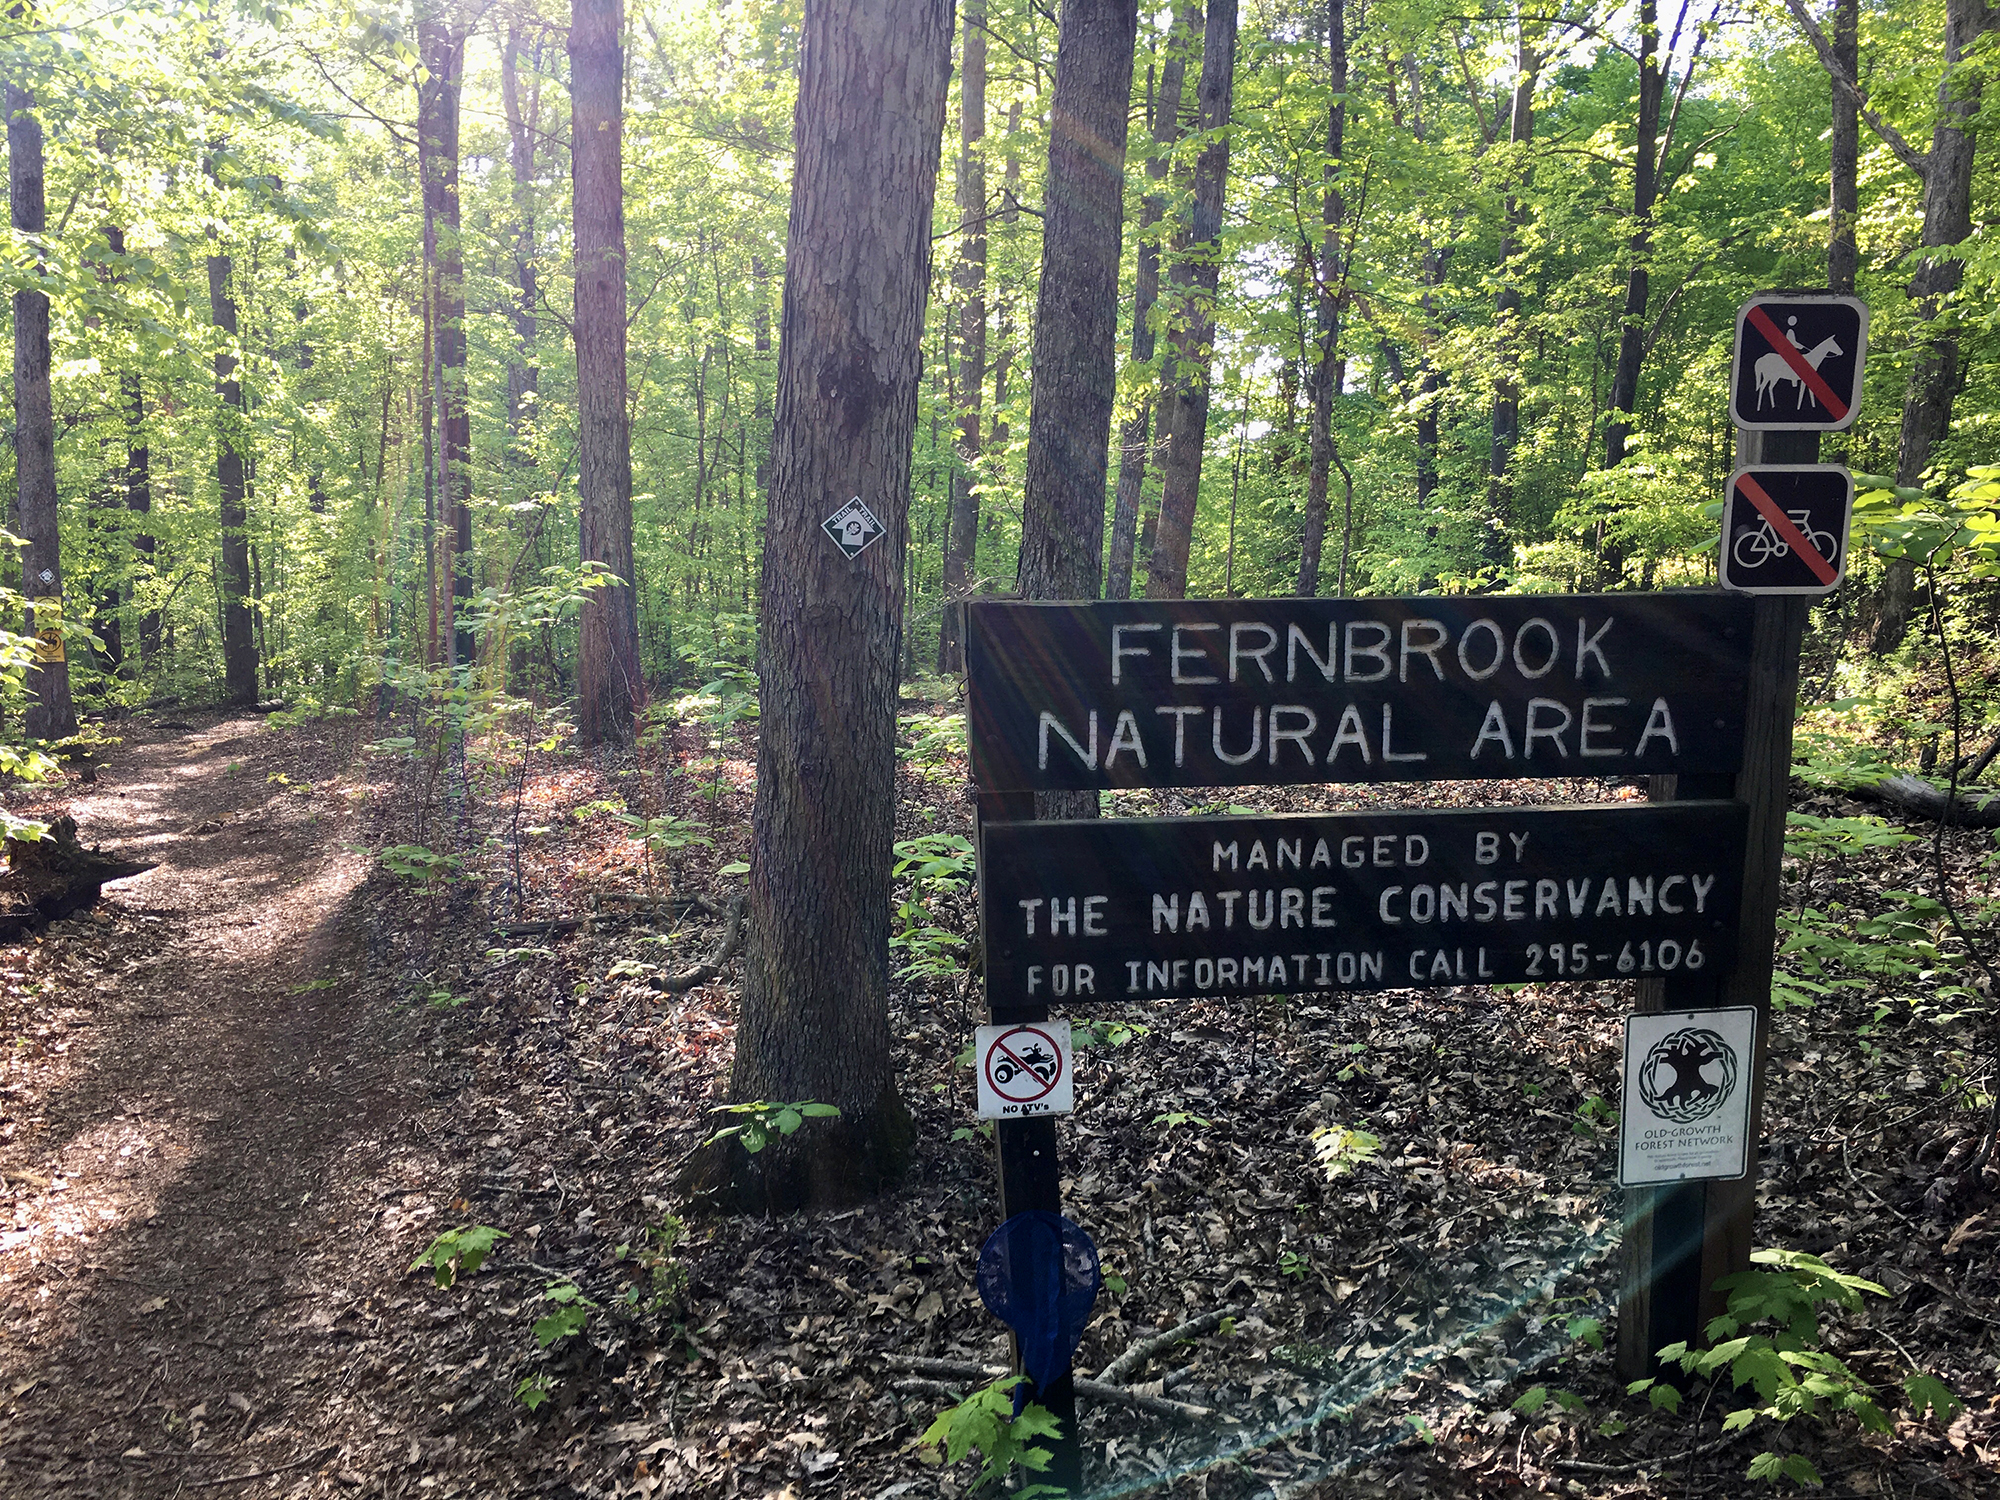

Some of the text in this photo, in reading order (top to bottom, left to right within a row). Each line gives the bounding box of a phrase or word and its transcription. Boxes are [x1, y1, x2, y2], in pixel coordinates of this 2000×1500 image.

[831, 506, 853, 524] TRAIL
[859, 507, 876, 528] TRAIL
[1111, 616, 1614, 685] FERNBROOK
[1038, 696, 1680, 771] NATURAL AREA
[1212, 831, 1530, 872] MANAGED BY
[1018, 873, 1715, 937] THE NATURE CONSERVANCY
[1027, 939, 1705, 996] FOR INFORMATION CALL 295-6106
[1002, 1105, 1018, 1114] NO
[1021, 1103, 1049, 1113] ATV's
[1635, 1135, 1733, 1151] FOREST NETWORK
[1644, 1125, 1721, 1140] OLD-GROWTH
